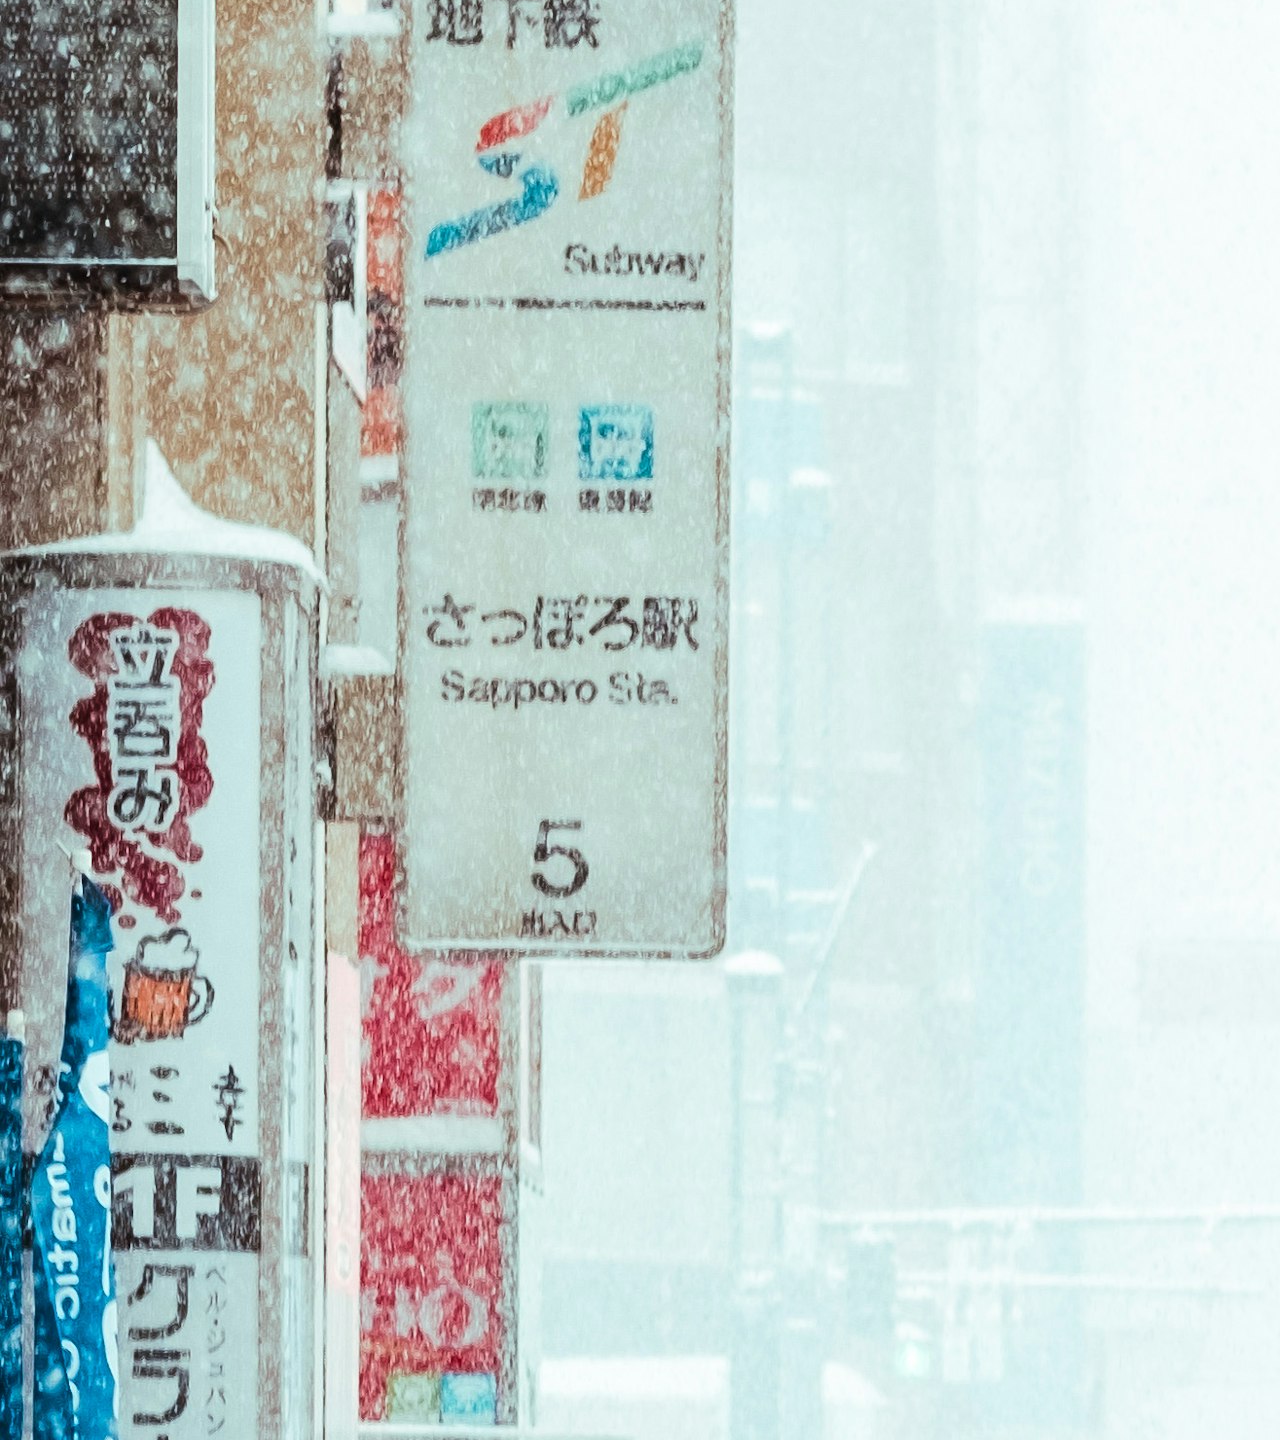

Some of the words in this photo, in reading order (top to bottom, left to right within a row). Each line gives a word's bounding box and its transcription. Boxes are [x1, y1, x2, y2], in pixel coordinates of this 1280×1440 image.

[563, 243, 706, 282] Subway
[440, 669, 599, 710] Sapporo
[607, 671, 680, 706] Sta.
[530, 818, 589, 899] 5
[114, 1166, 222, 1241] 1F
